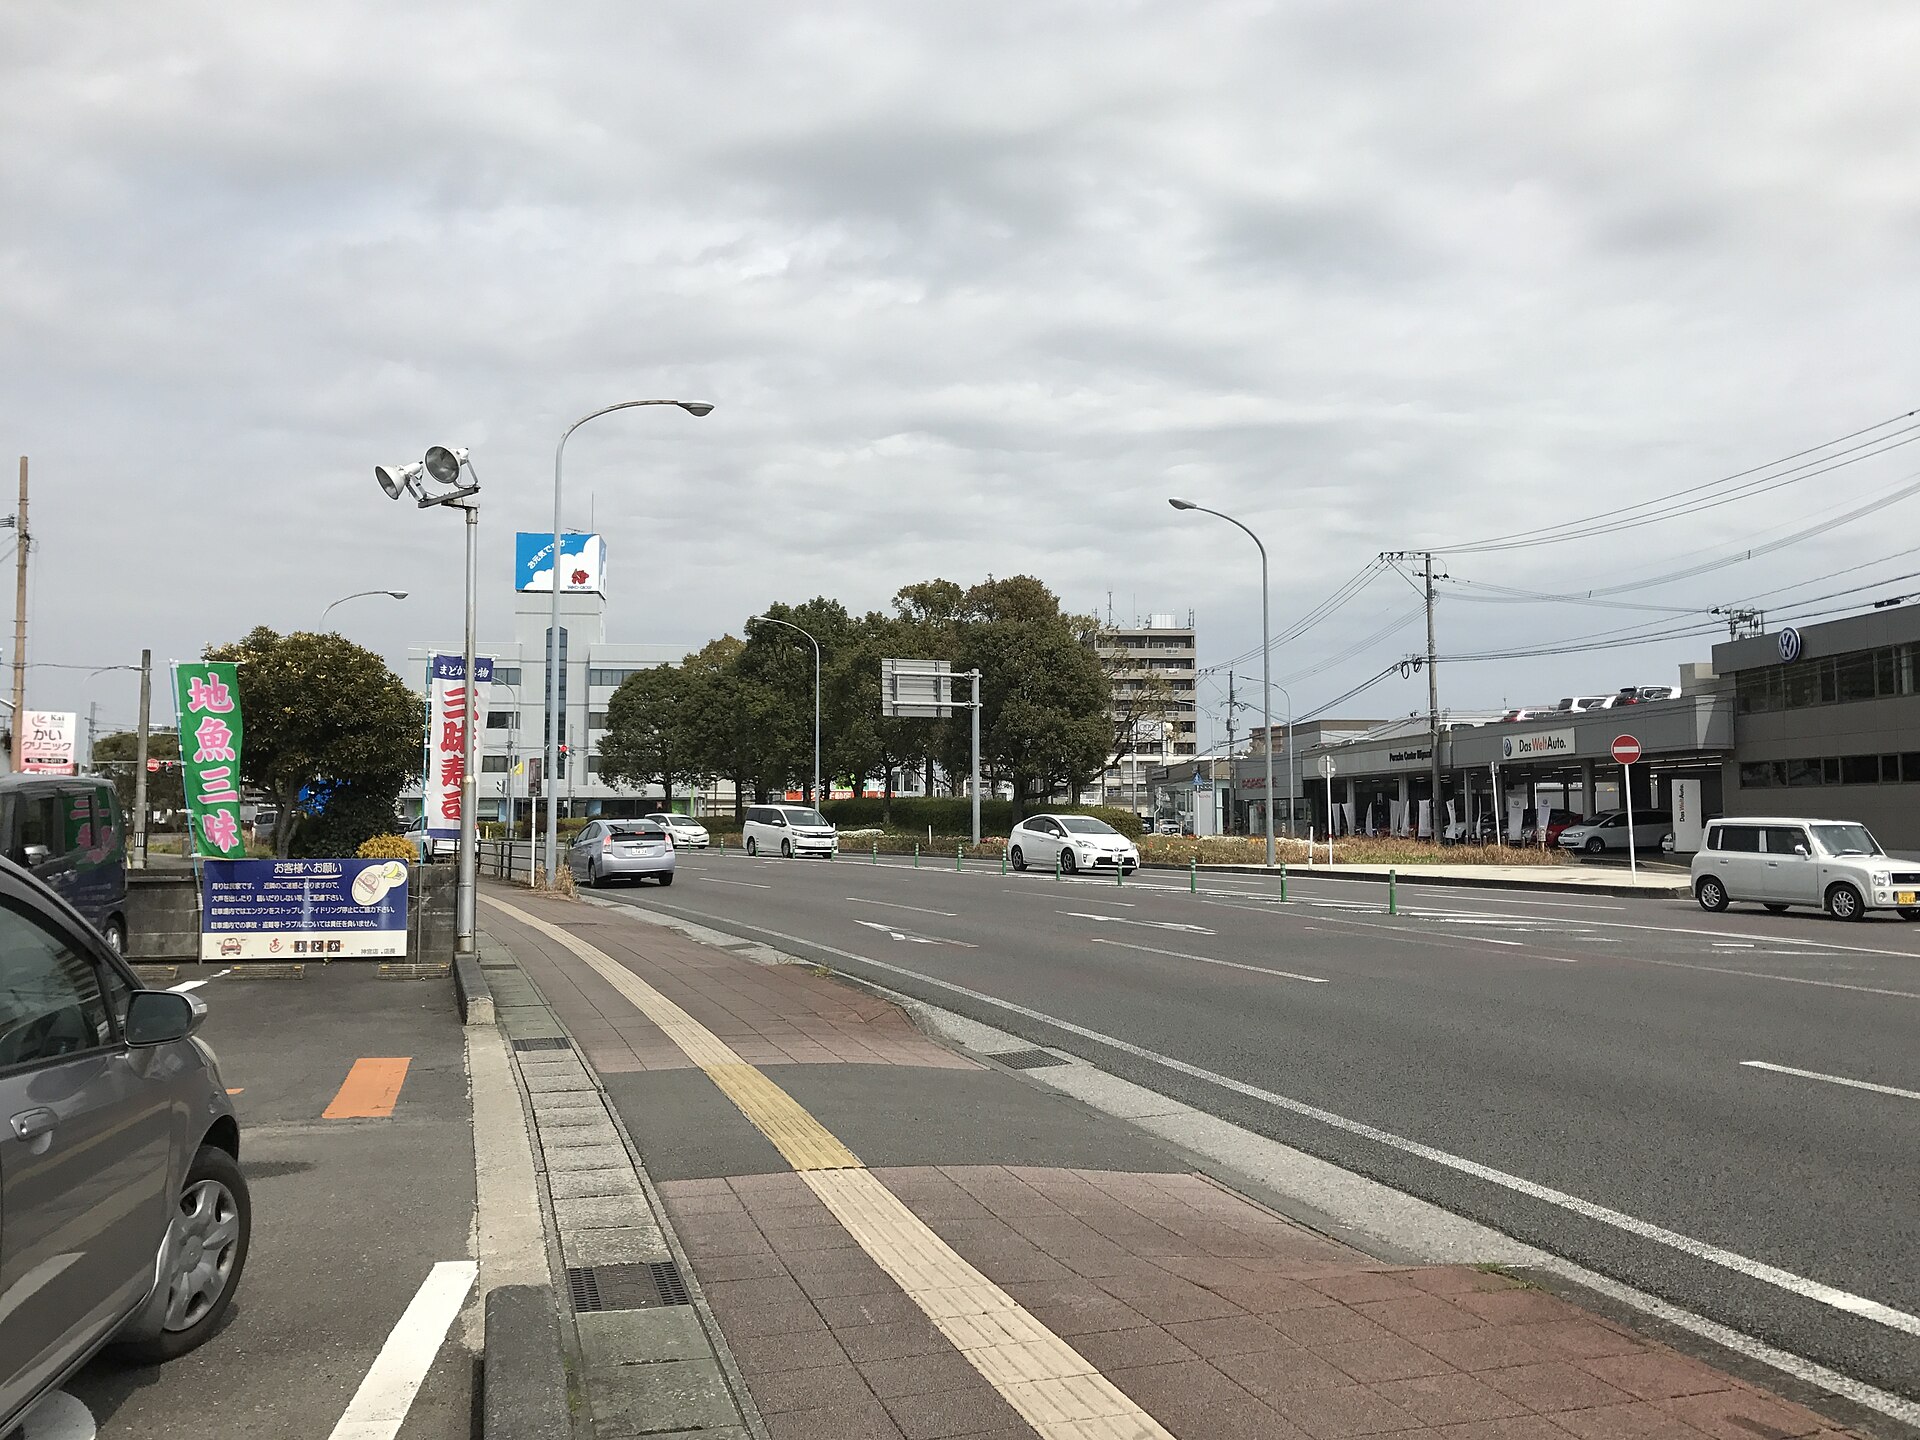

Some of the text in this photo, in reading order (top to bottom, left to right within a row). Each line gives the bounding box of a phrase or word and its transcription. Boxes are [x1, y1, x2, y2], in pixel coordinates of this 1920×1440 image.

[33, 729, 62, 741] かい
[22, 741, 72, 751] クリニック
[273, 862, 342, 874] お客様へお願い
